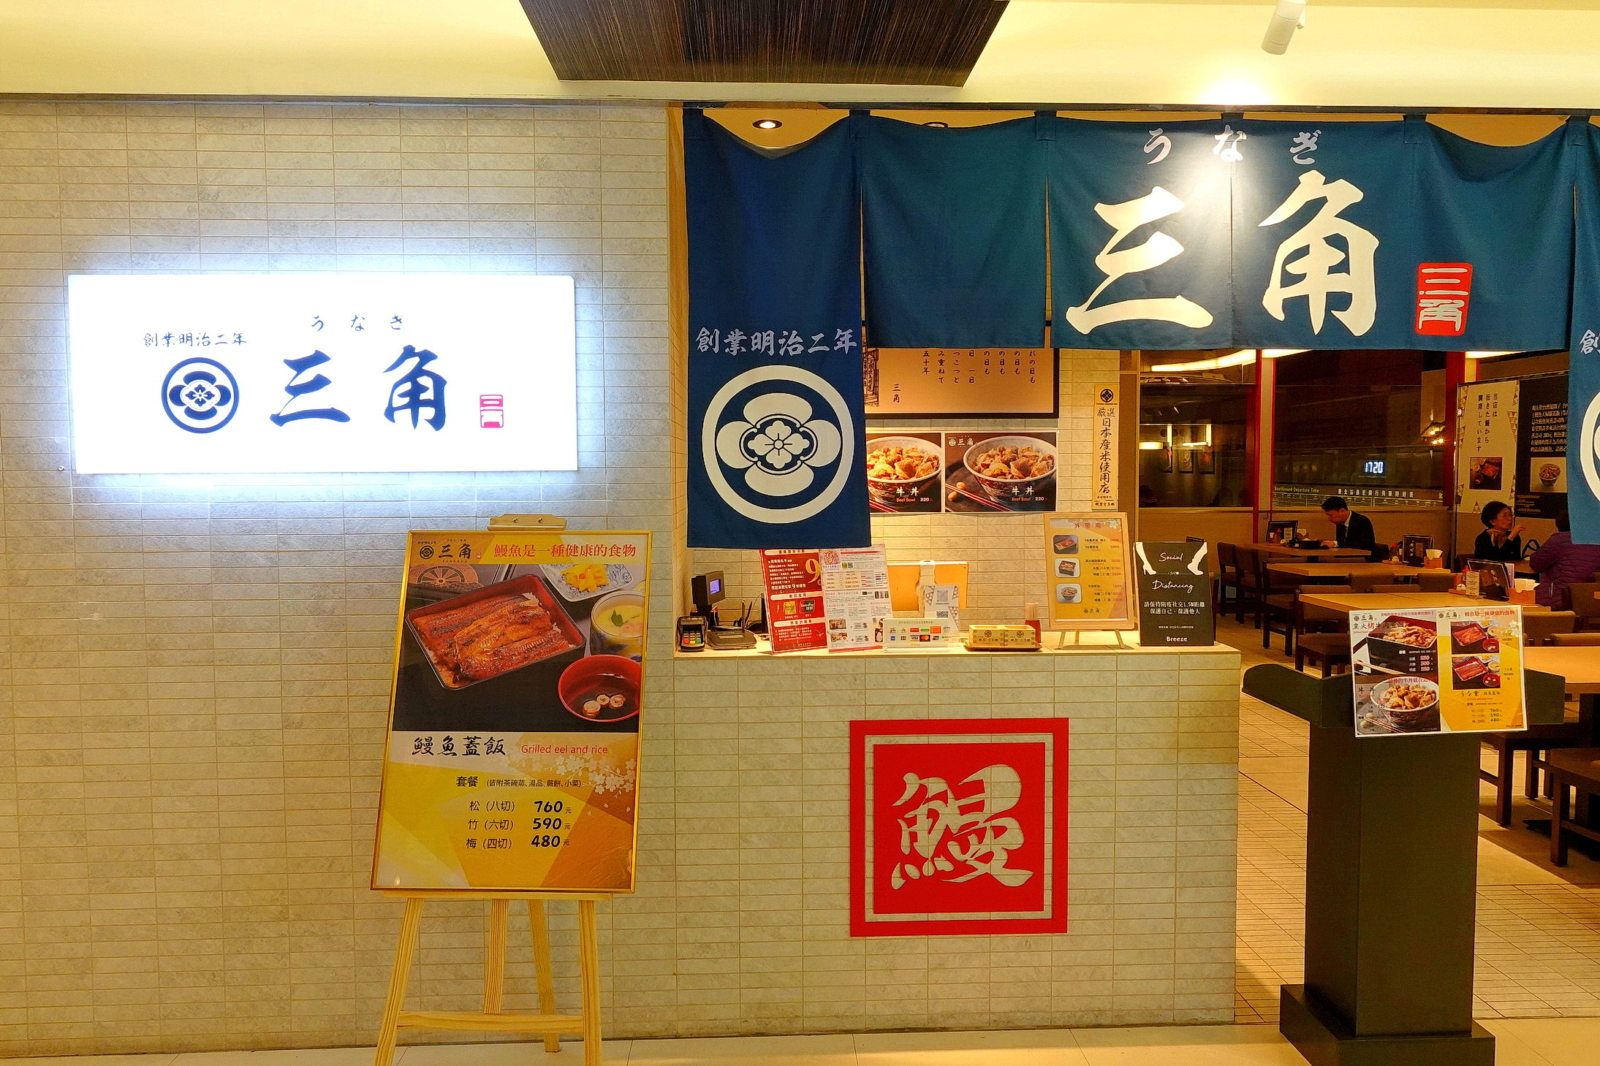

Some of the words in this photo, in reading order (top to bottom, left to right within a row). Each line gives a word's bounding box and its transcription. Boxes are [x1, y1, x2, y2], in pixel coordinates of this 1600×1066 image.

[1144, 124, 1321, 165] うなぎ
[1066, 169, 1379, 336] 三角
[144, 332, 247, 347] 創業明治二年
[695, 327, 857, 357] 創業明治二年
[922, 350, 930, 375] 五十年
[270, 344, 448, 431] 三角
[892, 383, 901, 403] 三角
[896, 486, 919, 497] 牛丼
[1012, 486, 1034, 496] 牛丼
[438, 543, 472, 559] 三角
[494, 544, 636, 557] 鰻魚是一種健康的食物
[1159, 552, 1184, 562] Social
[1152, 580, 1194, 594] Distancing
[411, 736, 506, 756] 鰻魚蓋飯
[521, 744, 551, 754] Grilled
[554, 744, 568, 754] eel
[570, 744, 588, 754] and
[591, 745, 608, 754] rice
[457, 776, 478, 787] 套餐
[469, 800, 480, 812] 松
[486, 800, 515, 812] (八切)
[534, 800, 563, 813] 760
[468, 819, 478, 831] 竹
[484, 819, 514, 831] (六切)
[532, 817, 562, 830] 590
[891, 764, 1034, 890] 鰻
[466, 838, 477, 849] 梅
[482, 838, 512, 849] (四切)
[531, 835, 561, 848] 480
